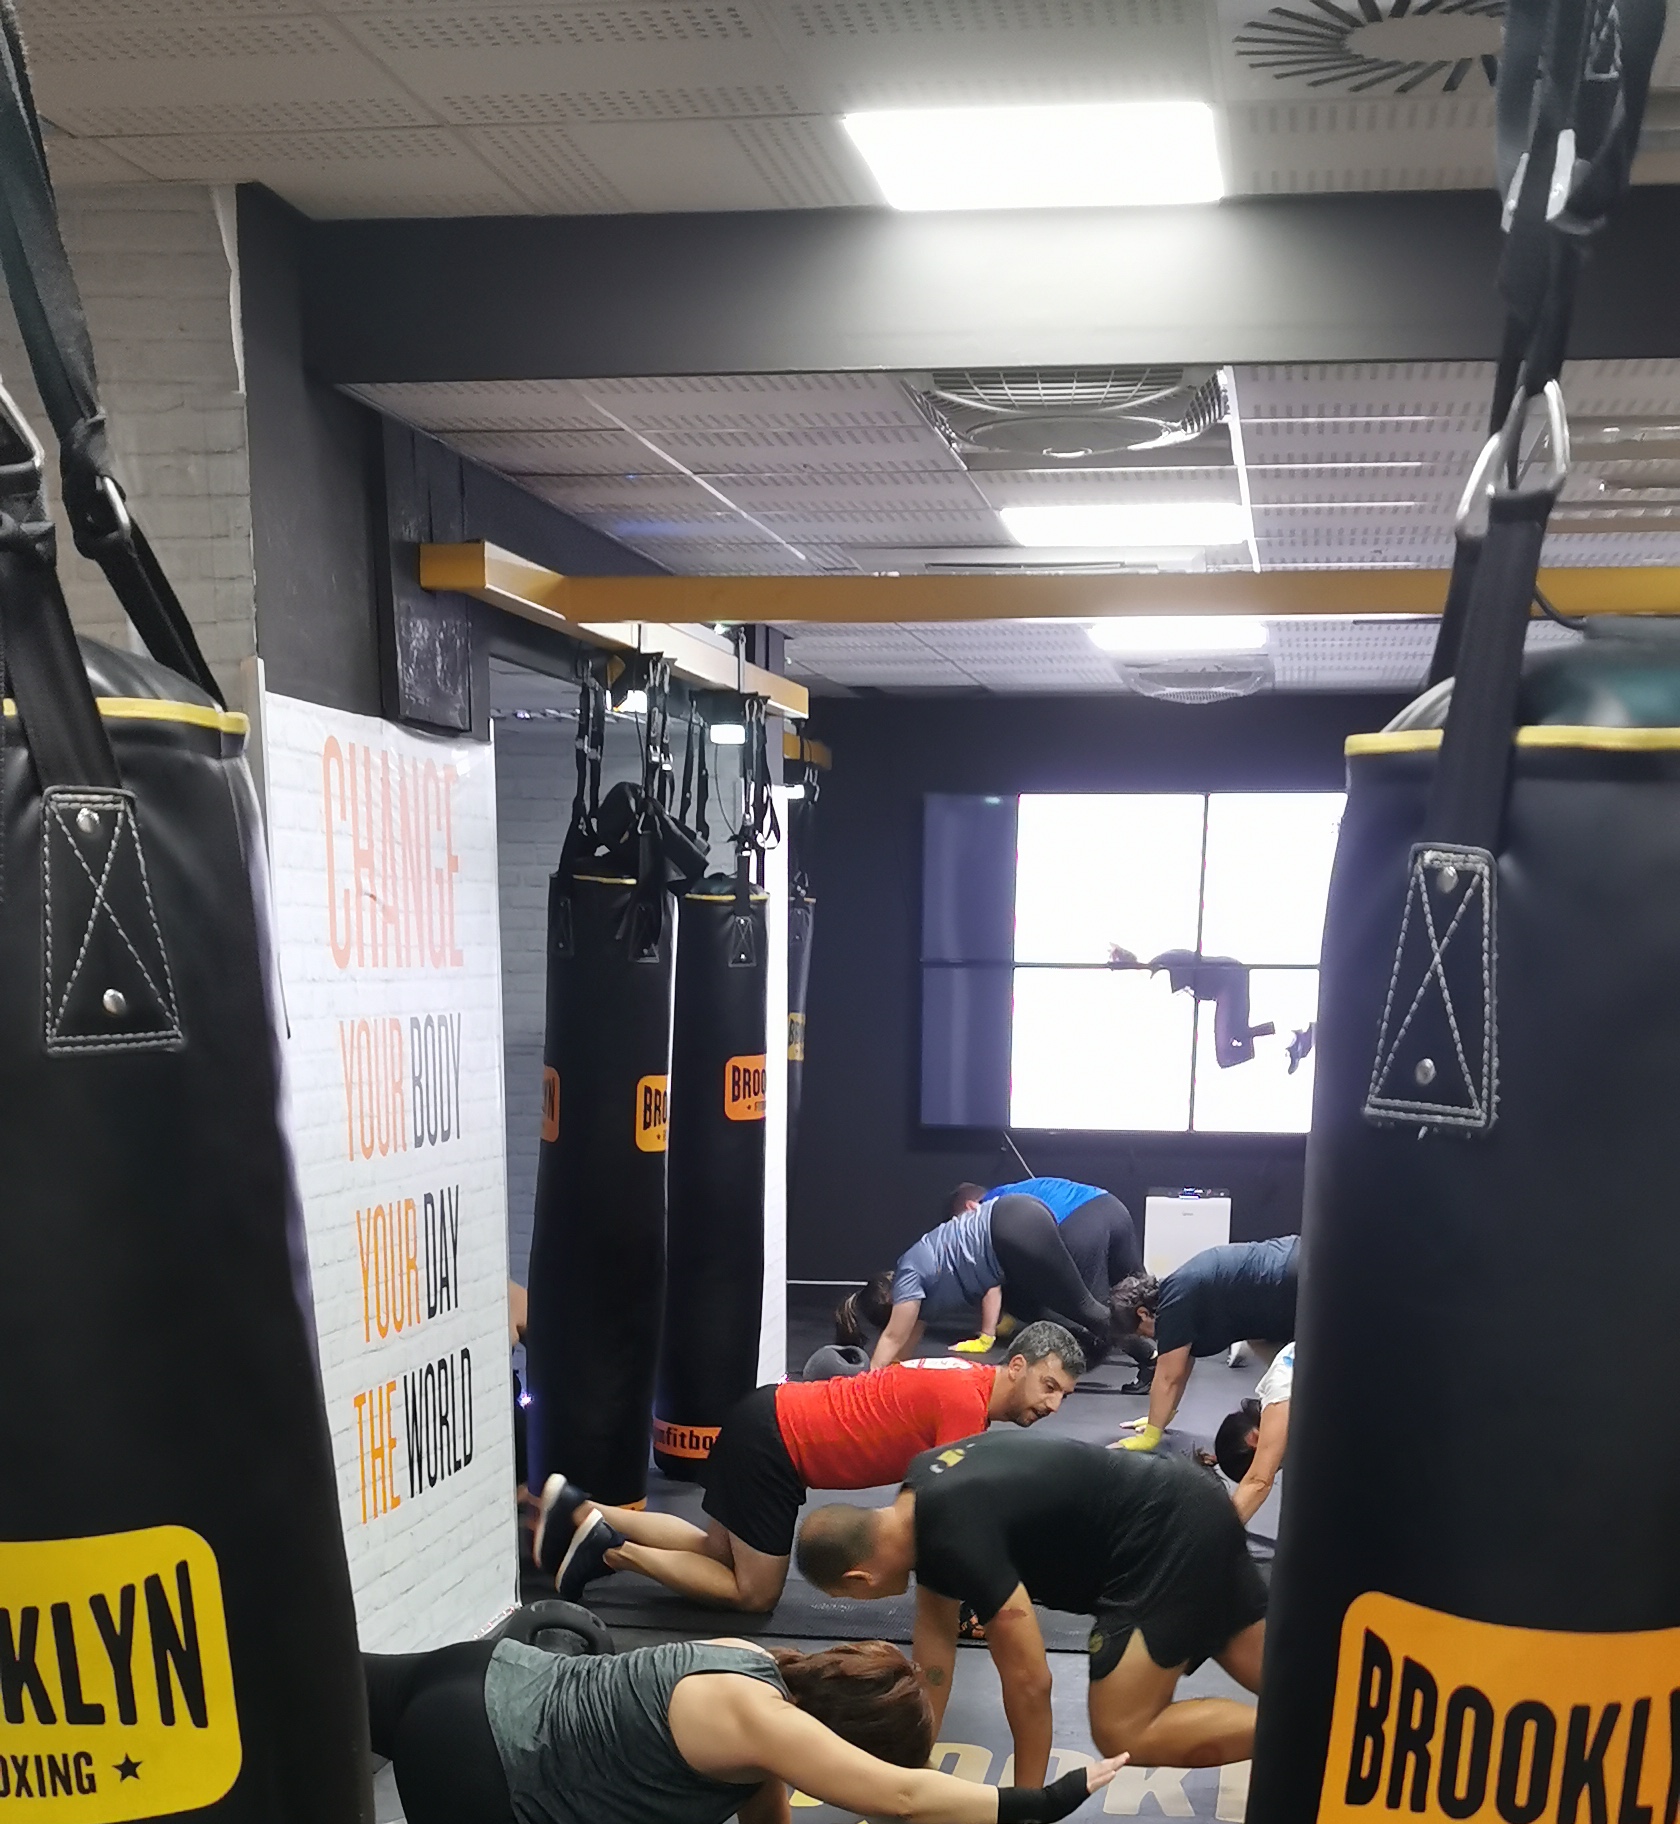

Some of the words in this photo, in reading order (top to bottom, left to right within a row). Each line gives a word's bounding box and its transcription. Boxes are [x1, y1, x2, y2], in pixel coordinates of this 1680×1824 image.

[323, 735, 464, 969] CHANGE
[339, 1017, 407, 1162] YOUR
[410, 1012, 461, 1149] BODY
[356, 1198, 420, 1343] YOUR
[424, 1184, 459, 1320] DAY
[353, 1380, 400, 1524] THE
[403, 1347, 473, 1499] WORLD
[654, 1427, 720, 1451] fitbo
